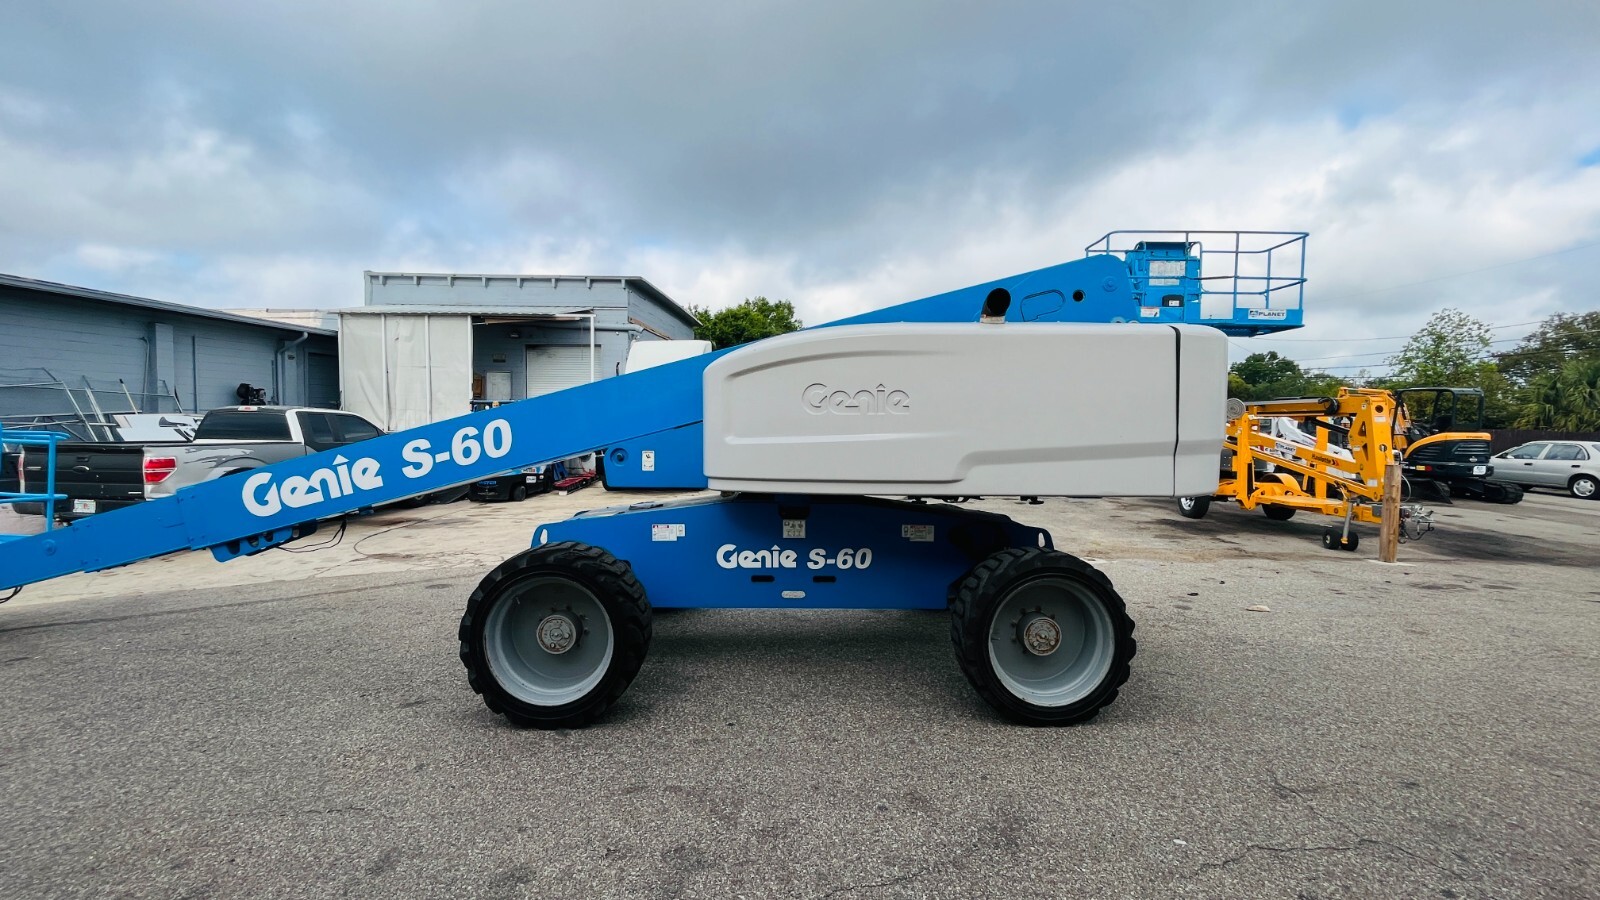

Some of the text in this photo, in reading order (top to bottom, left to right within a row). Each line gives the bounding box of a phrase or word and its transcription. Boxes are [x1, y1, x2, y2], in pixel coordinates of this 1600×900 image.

[802, 383, 910, 415] Genie
[242, 419, 512, 517] Genie S-60
[716, 543, 872, 570] Genie S-60
